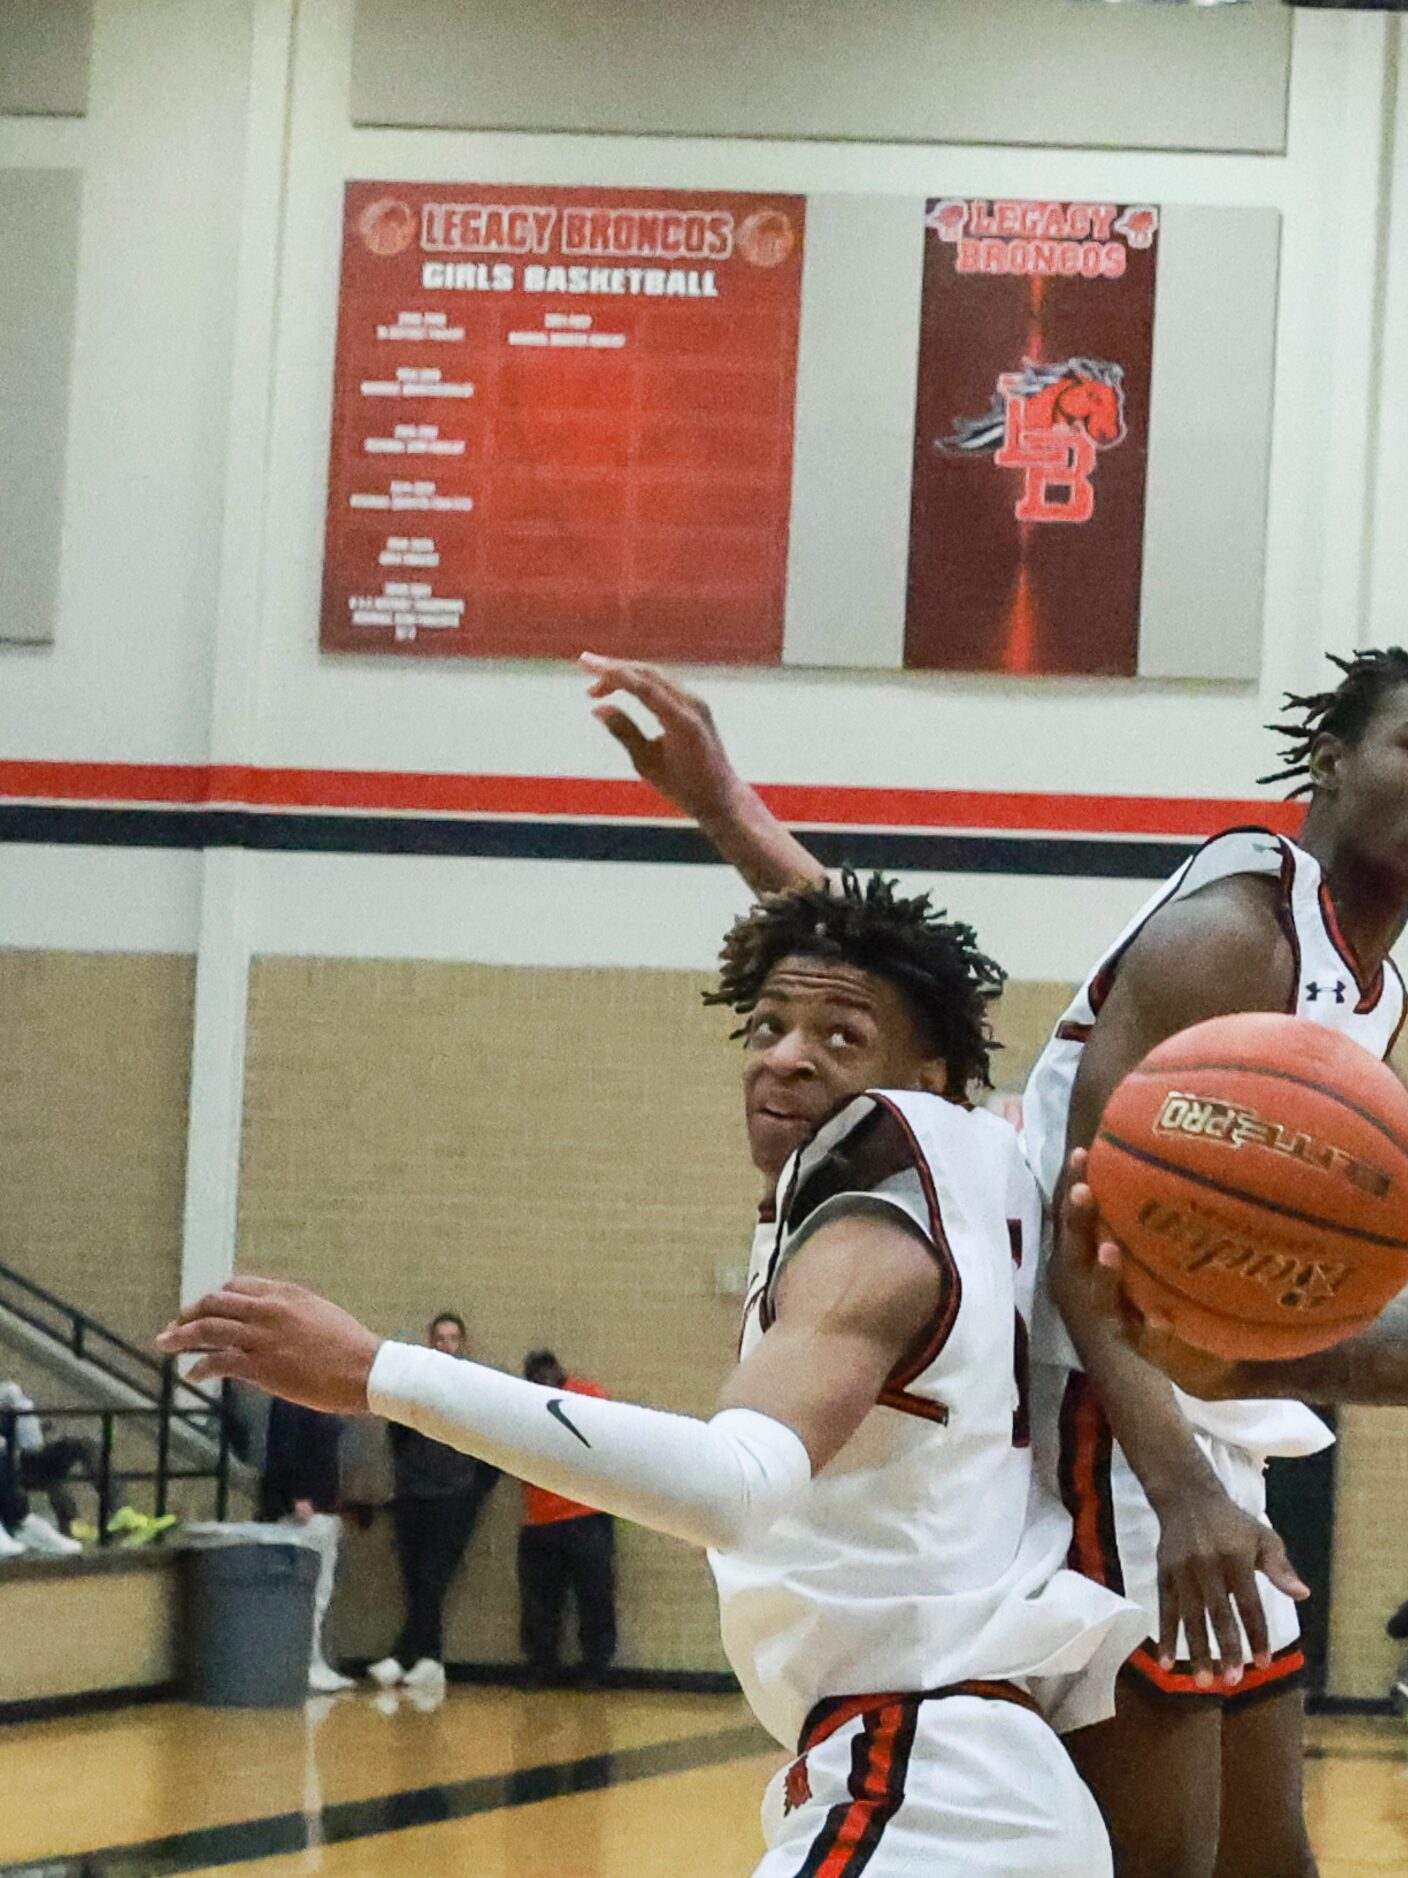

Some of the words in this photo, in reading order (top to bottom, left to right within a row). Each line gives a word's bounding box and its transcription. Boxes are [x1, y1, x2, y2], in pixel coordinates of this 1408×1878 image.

[421, 203, 557, 254] LEGACY
[561, 208, 735, 260] BRONCOS
[970, 200, 1117, 240] LEGACY
[956, 238, 1127, 278] BRONCOS
[422, 261, 515, 292] GIRLS
[524, 264, 719, 297] BASKETBALL
